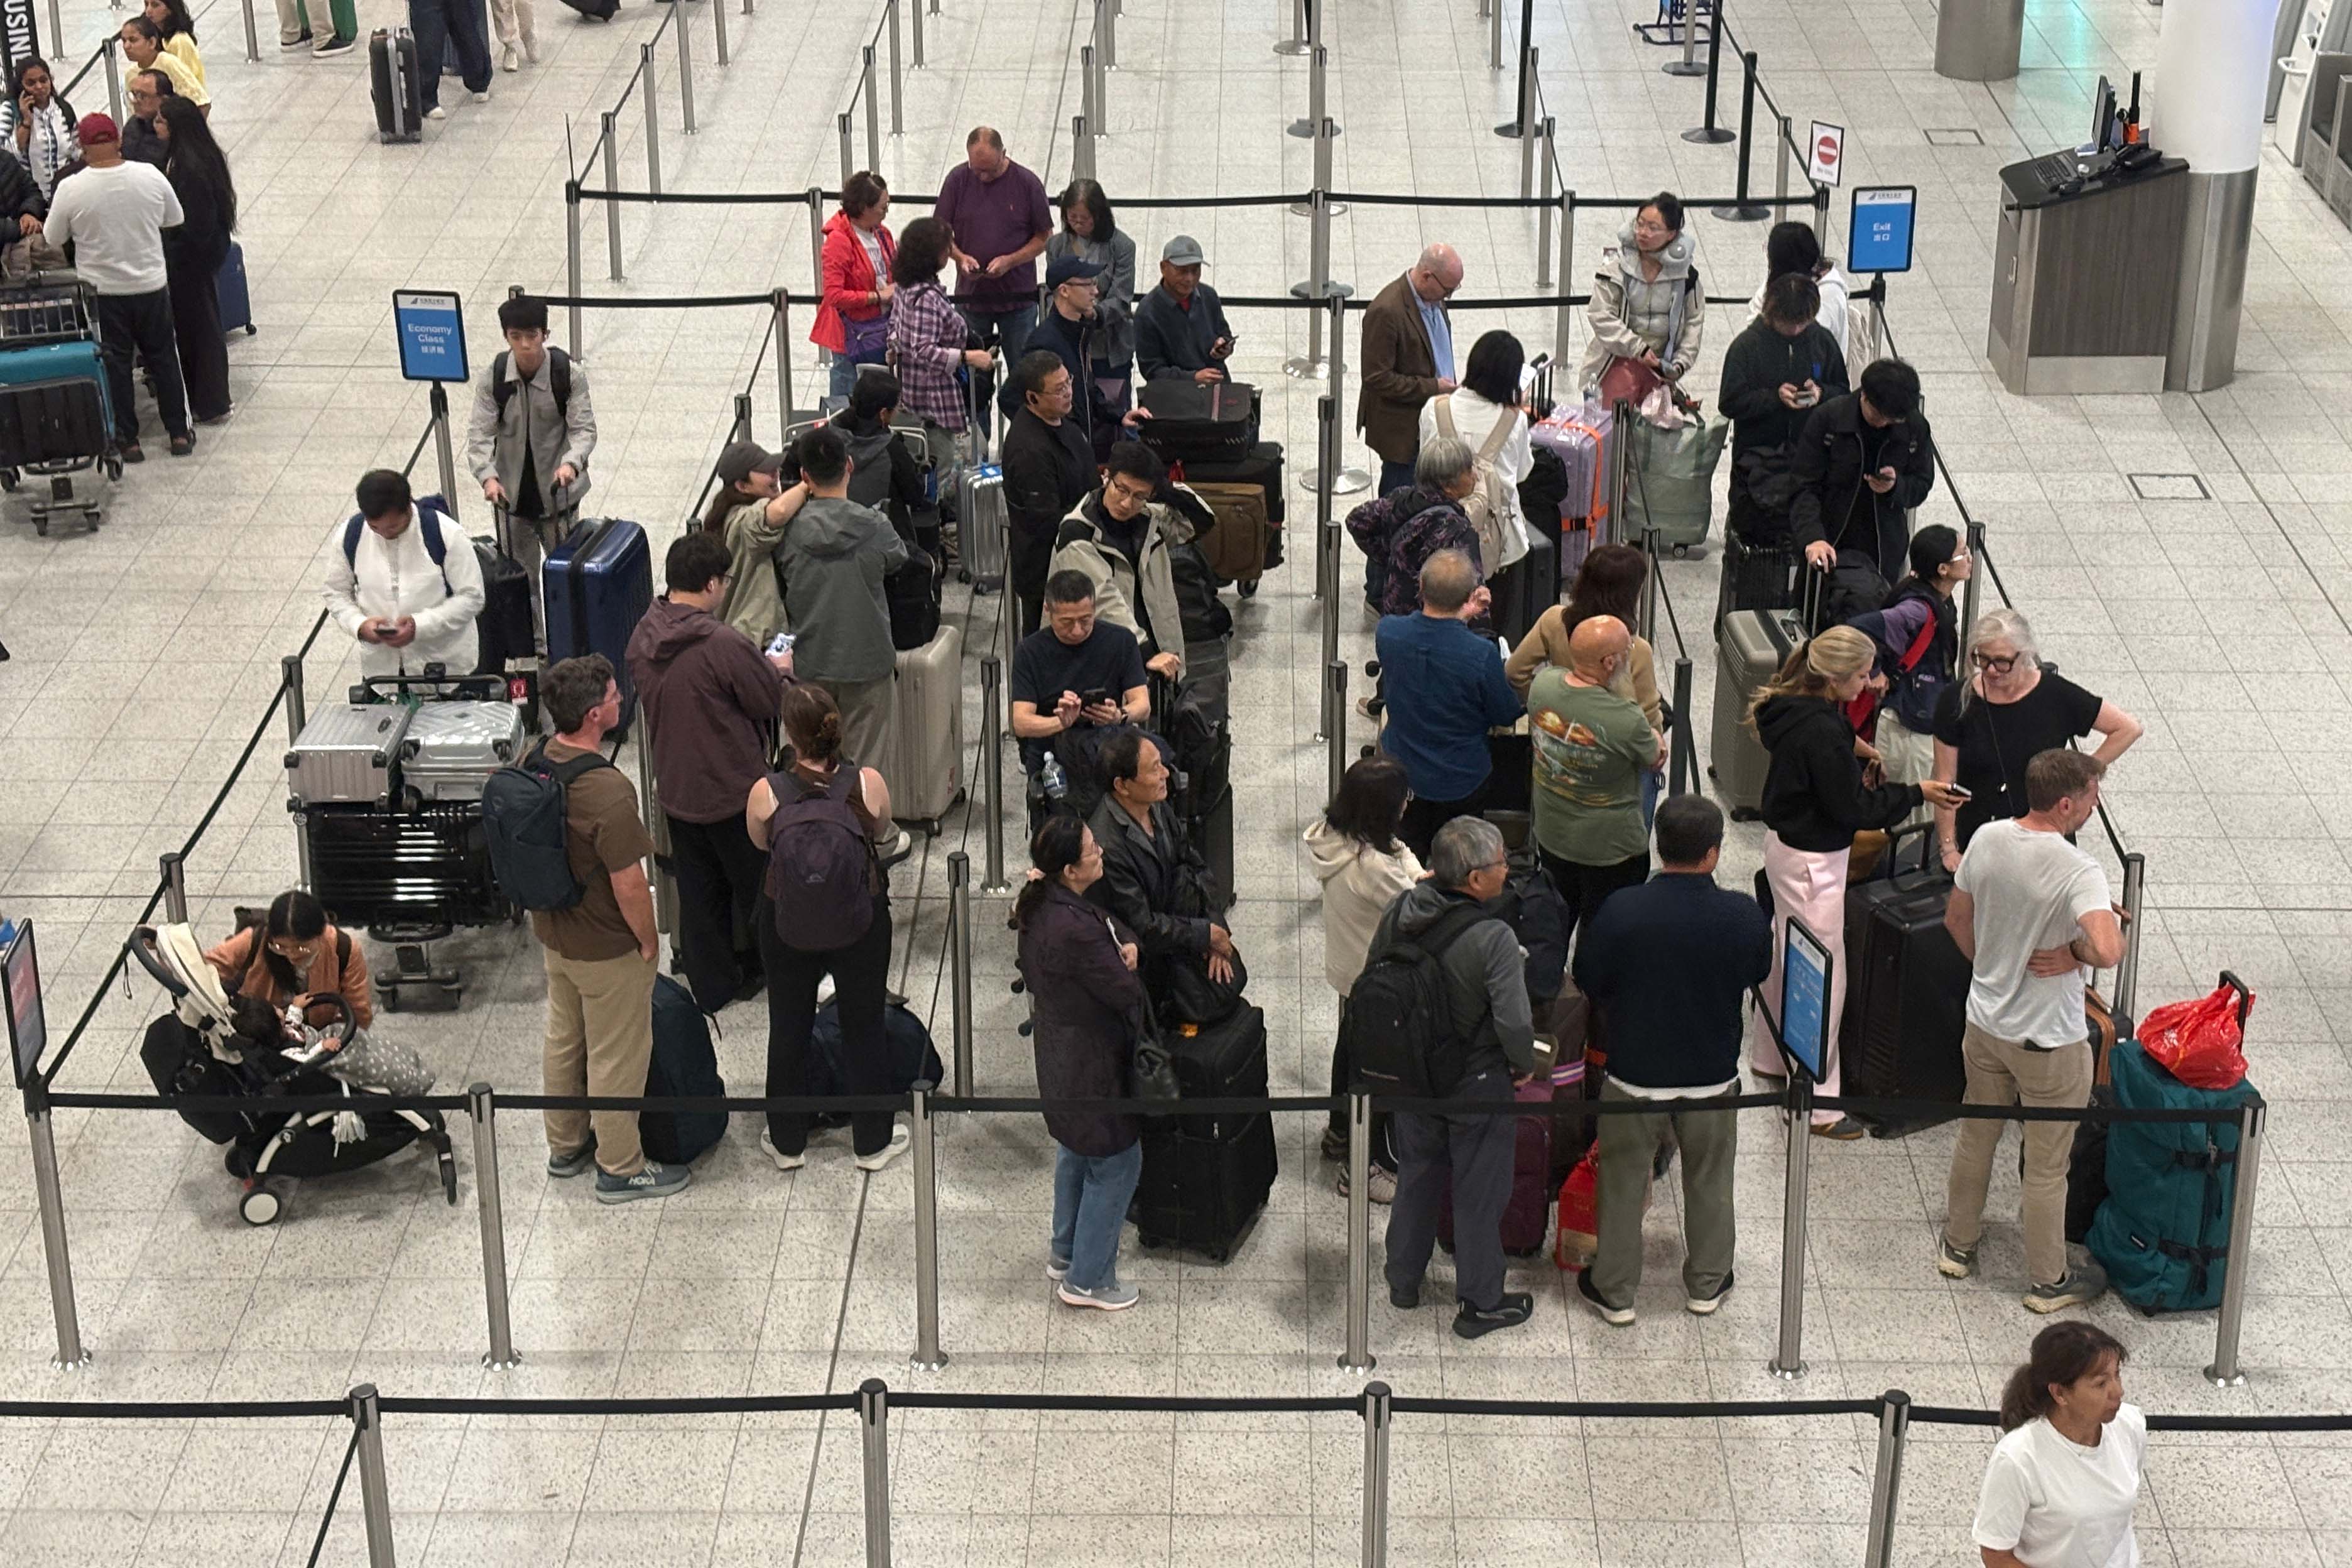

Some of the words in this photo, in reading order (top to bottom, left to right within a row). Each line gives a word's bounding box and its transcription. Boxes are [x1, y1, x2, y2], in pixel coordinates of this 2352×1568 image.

[1873, 223, 1891, 231] Exit
[408, 324, 452, 335] Economy
[418, 334, 444, 343] Class
[628, 1176, 656, 1186] HOKA
